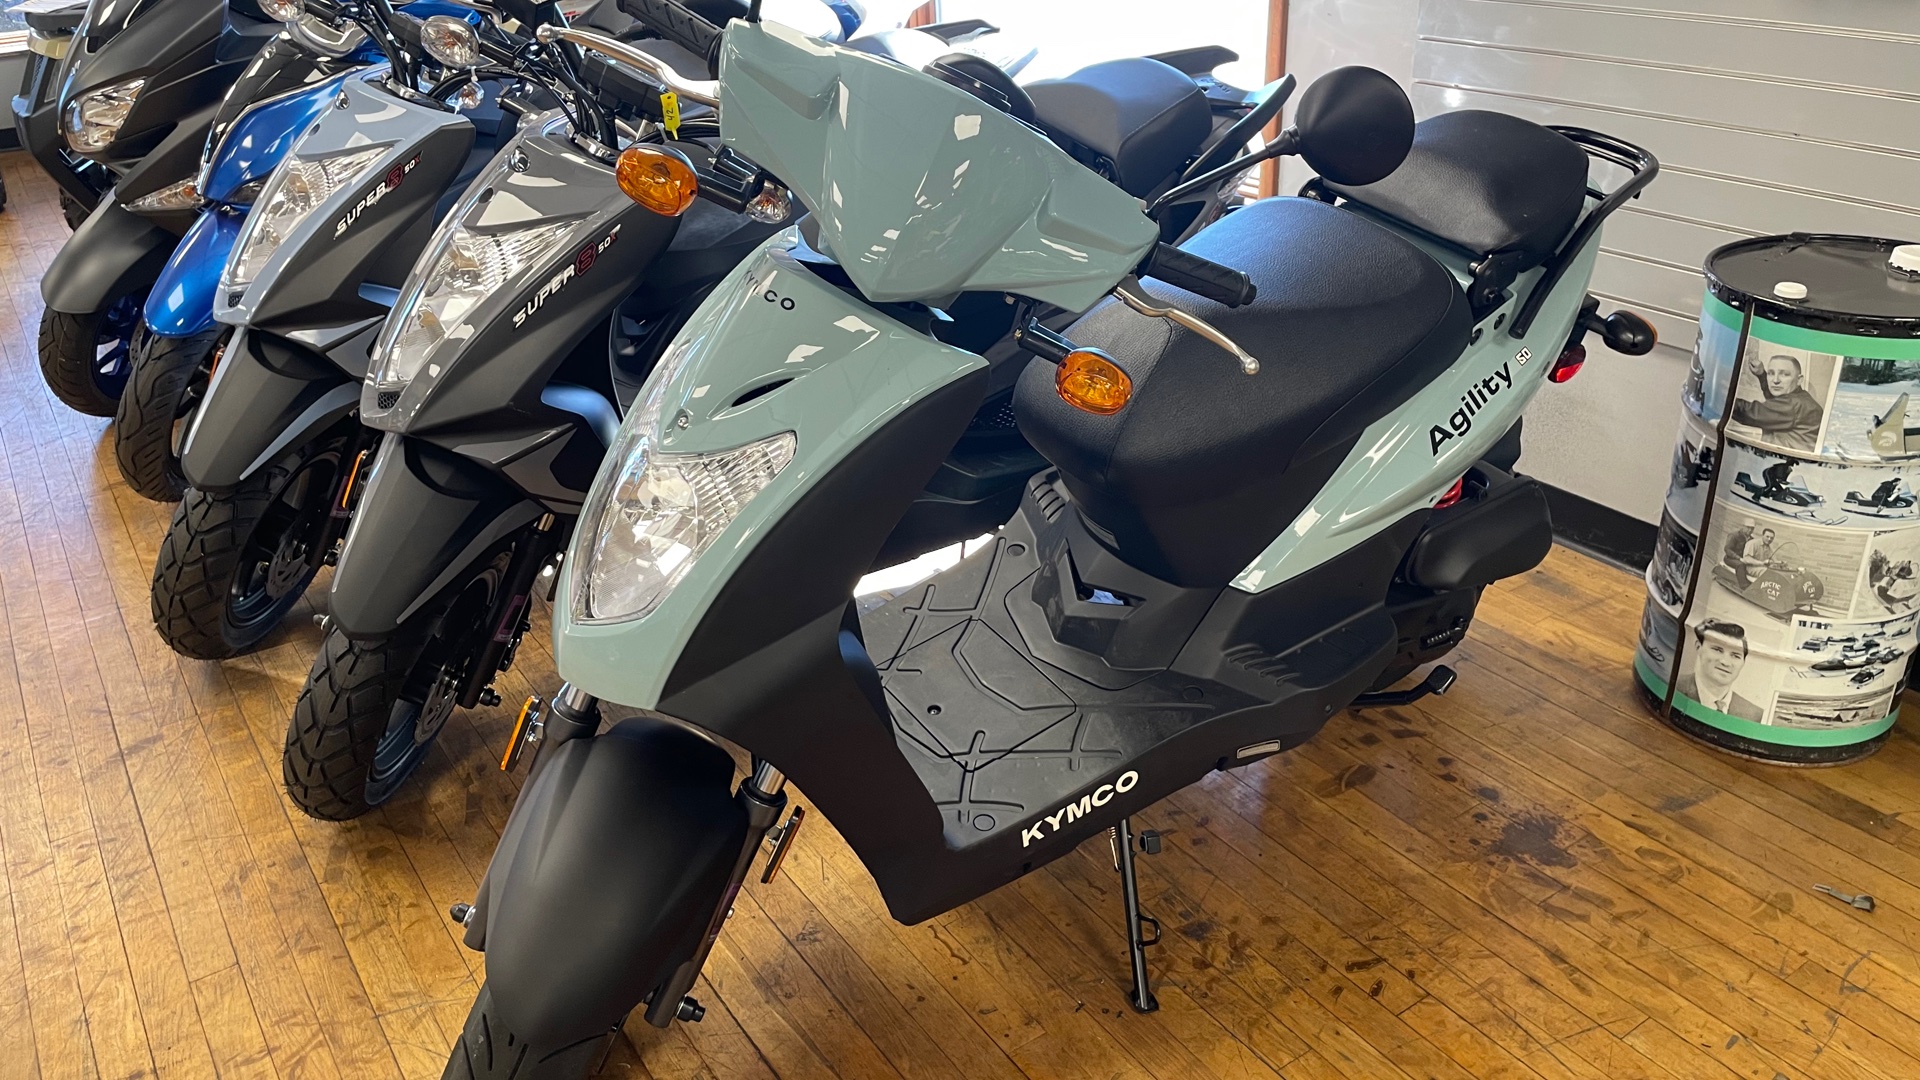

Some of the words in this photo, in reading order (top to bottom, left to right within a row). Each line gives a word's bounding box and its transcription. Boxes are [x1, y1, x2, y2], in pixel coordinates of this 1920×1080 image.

[335, 181, 387, 238] SUPER
[512, 263, 575, 329] SUPER
[1429, 361, 1513, 457] Agility
[1514, 345, 1533, 367] 50
[1760, 581, 1781, 591] ARCTIC
[1766, 588, 1780, 598] CAT
[1021, 770, 1139, 848] KYMCO
